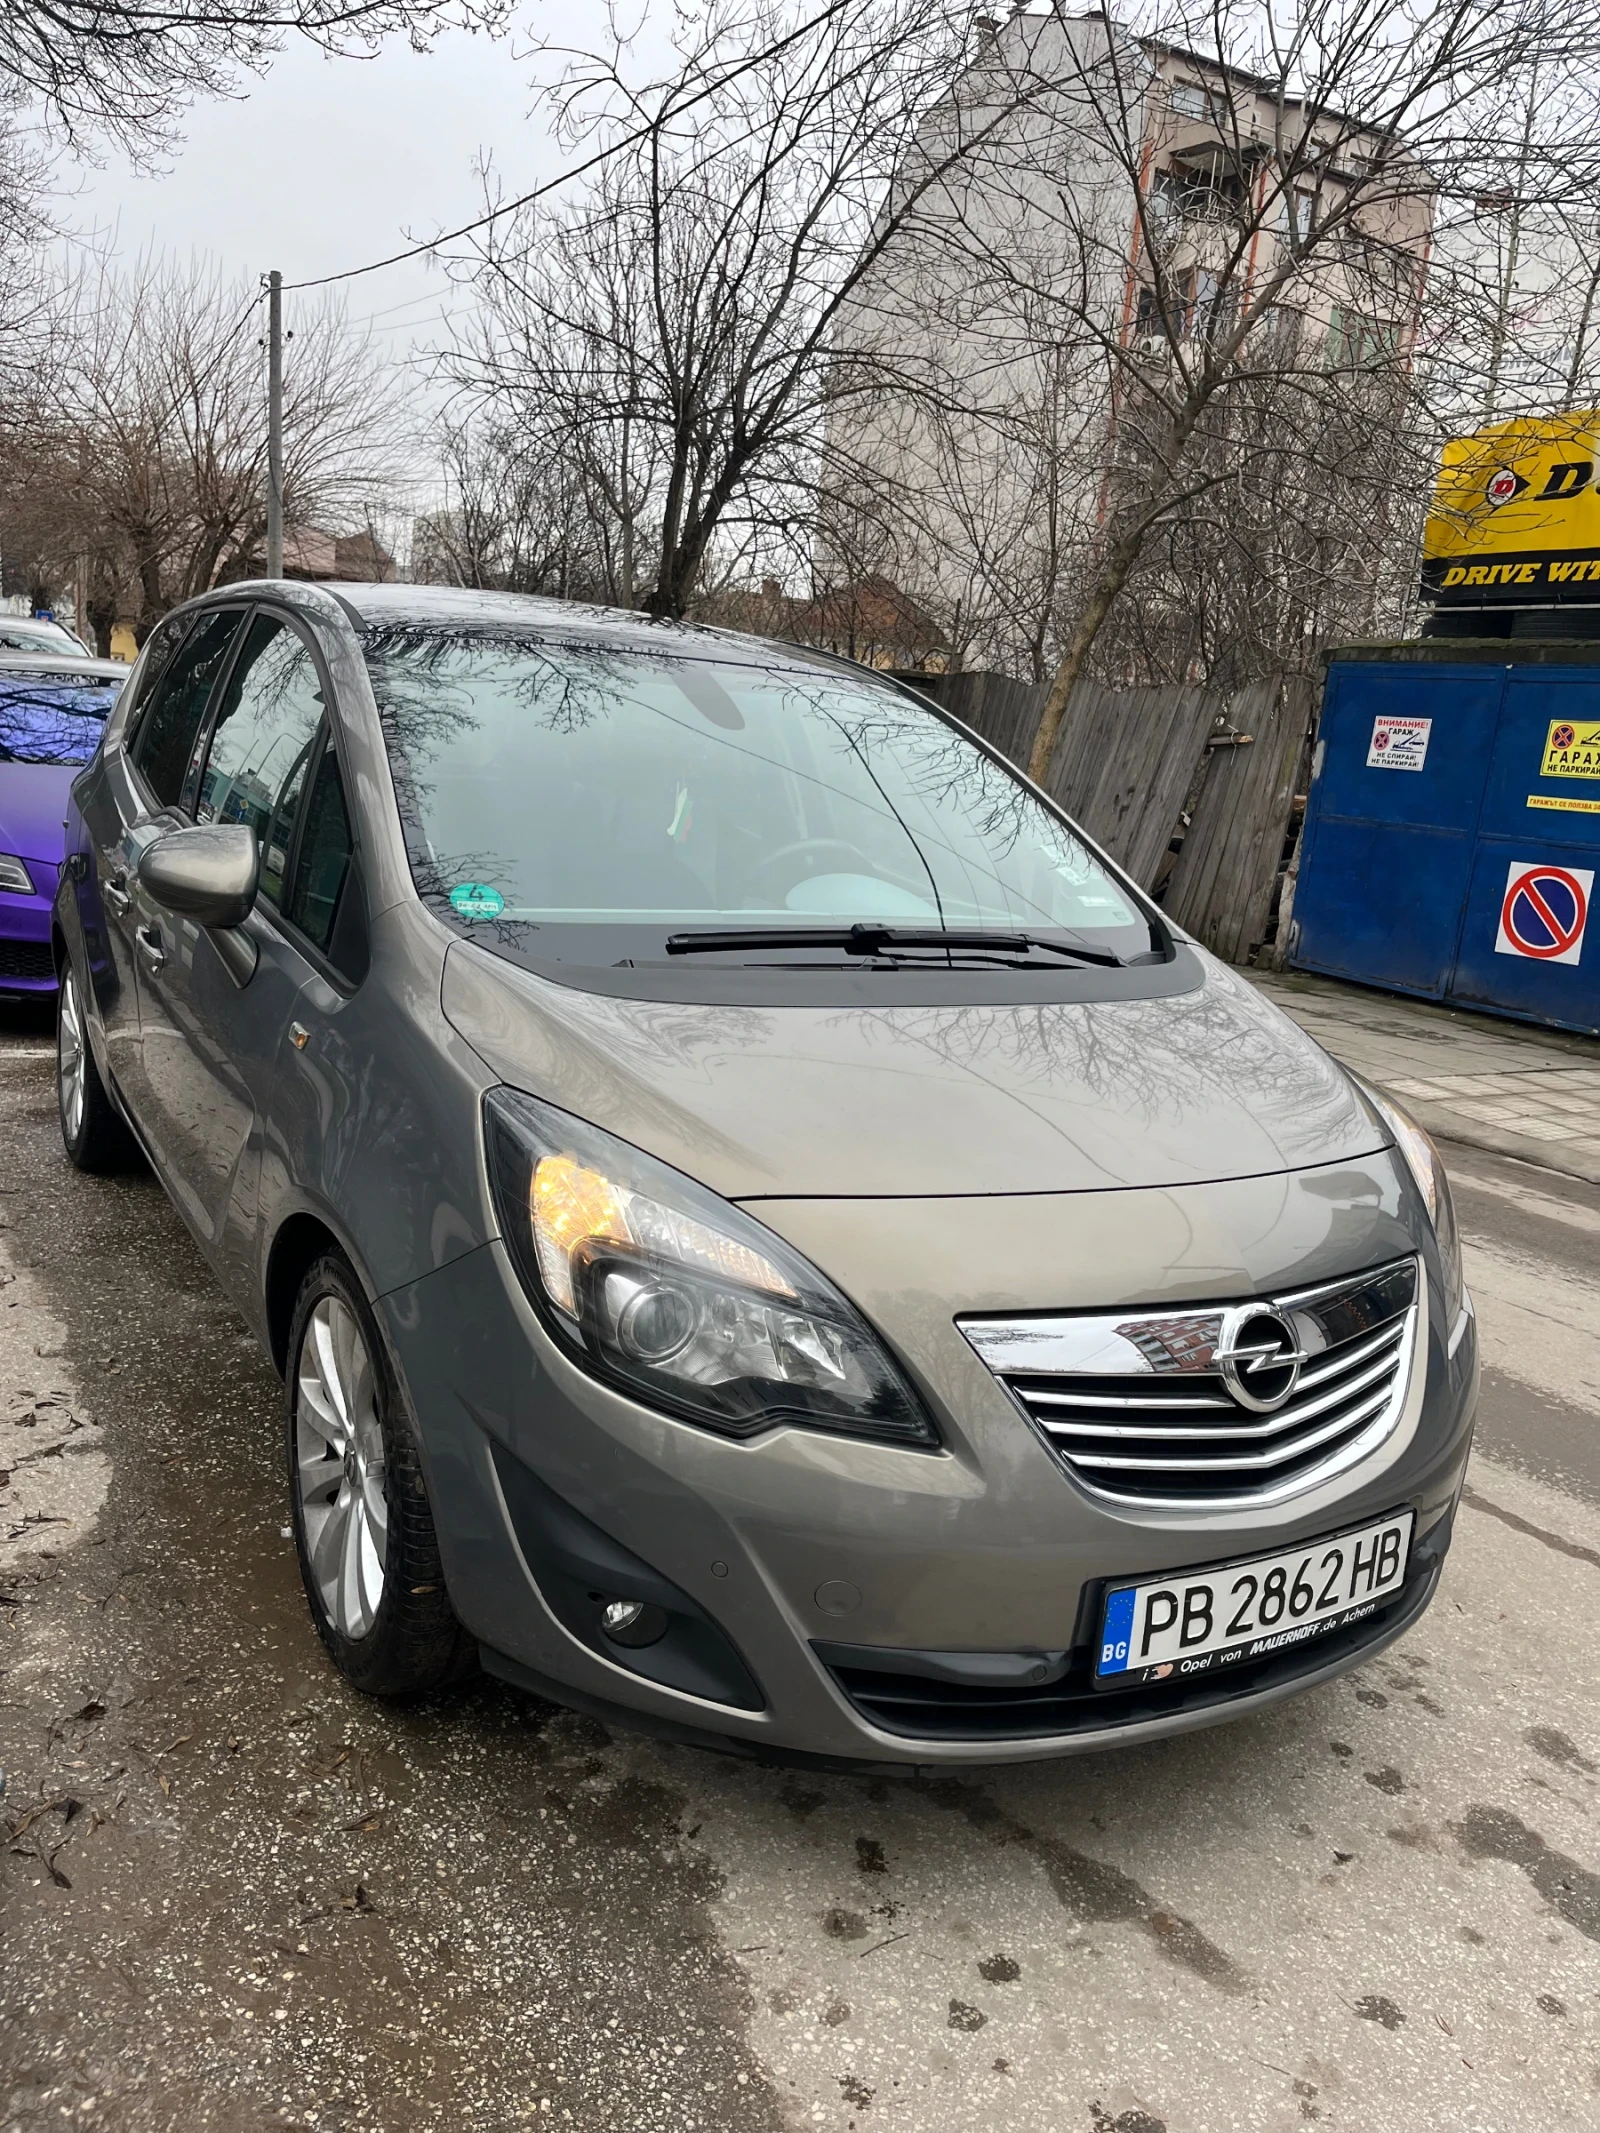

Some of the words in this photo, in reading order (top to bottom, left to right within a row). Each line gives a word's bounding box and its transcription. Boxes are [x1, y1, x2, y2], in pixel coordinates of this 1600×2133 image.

[1441, 562, 1542, 587] DRIVE
[1377, 718, 1429, 729] ВНИМАНИЕ!
[1388, 727, 1415, 736] ГАРАЖ
[1387, 752, 1417, 761] СПИРАЙ!
[1381, 758, 1420, 768] ПАРКИРАЙ!
[1547, 764, 1558, 772] НЕ
[1529, 798, 1558, 807] ГАРАЖЪТ
[1559, 800, 1567, 808] СЕ
[1568, 801, 1593, 810] ПОЛЗВА
[1180, 1654, 1213, 1673] Opel
[1220, 1650, 1242, 1663] von
[1341, 1602, 1375, 1624] Achern
[1102, 1641, 1127, 1663] BG
